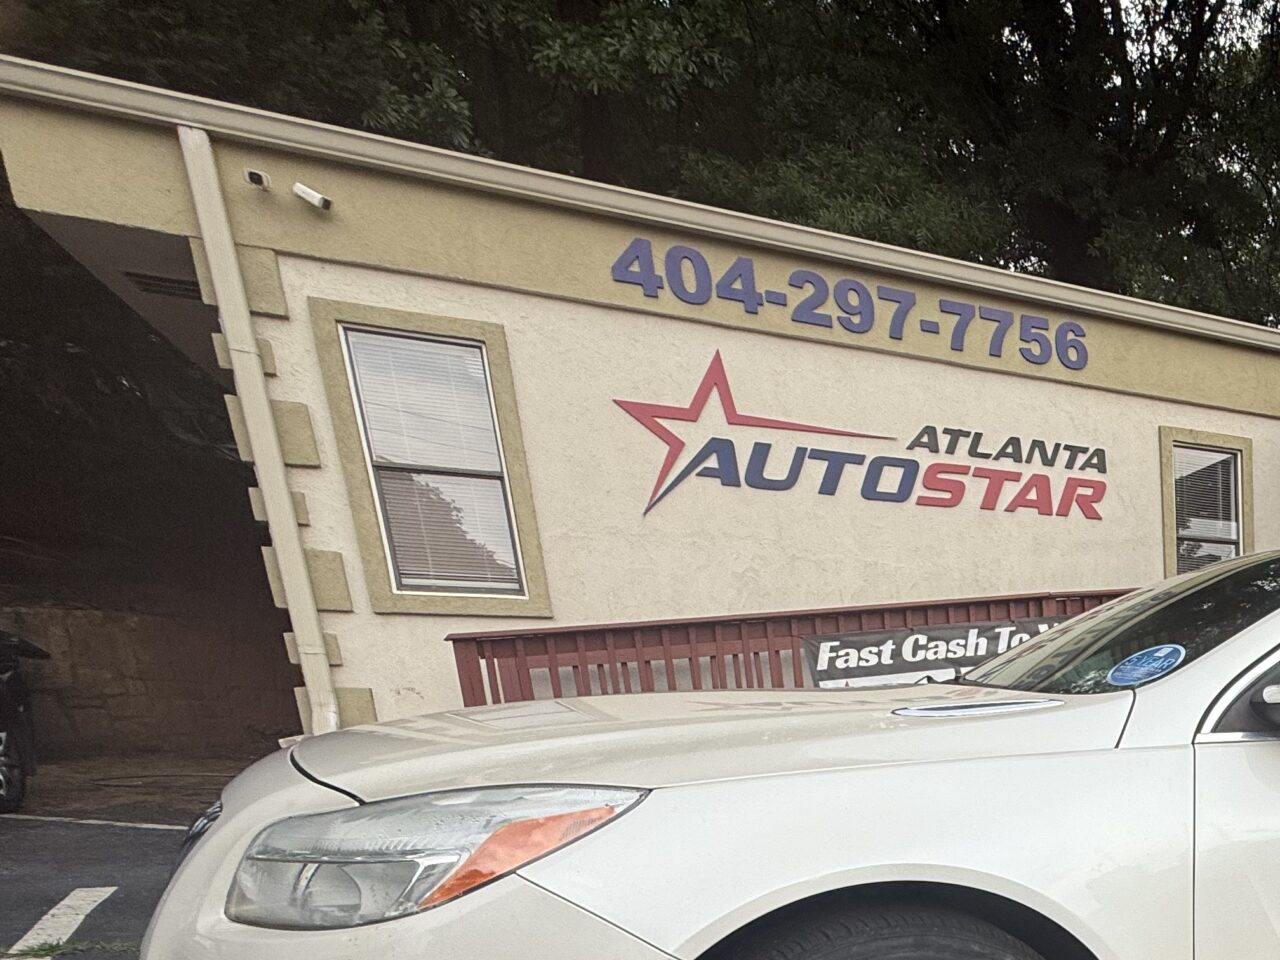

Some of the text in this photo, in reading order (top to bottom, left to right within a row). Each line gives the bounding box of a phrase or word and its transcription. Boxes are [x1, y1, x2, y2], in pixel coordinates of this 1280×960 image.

[611, 237, 1089, 370] 404-297-7756
[906, 425, 1107, 473] ATLANTA
[816, 627, 1030, 670] Fast Cash To
[1139, 655, 1176, 669] YEAR
